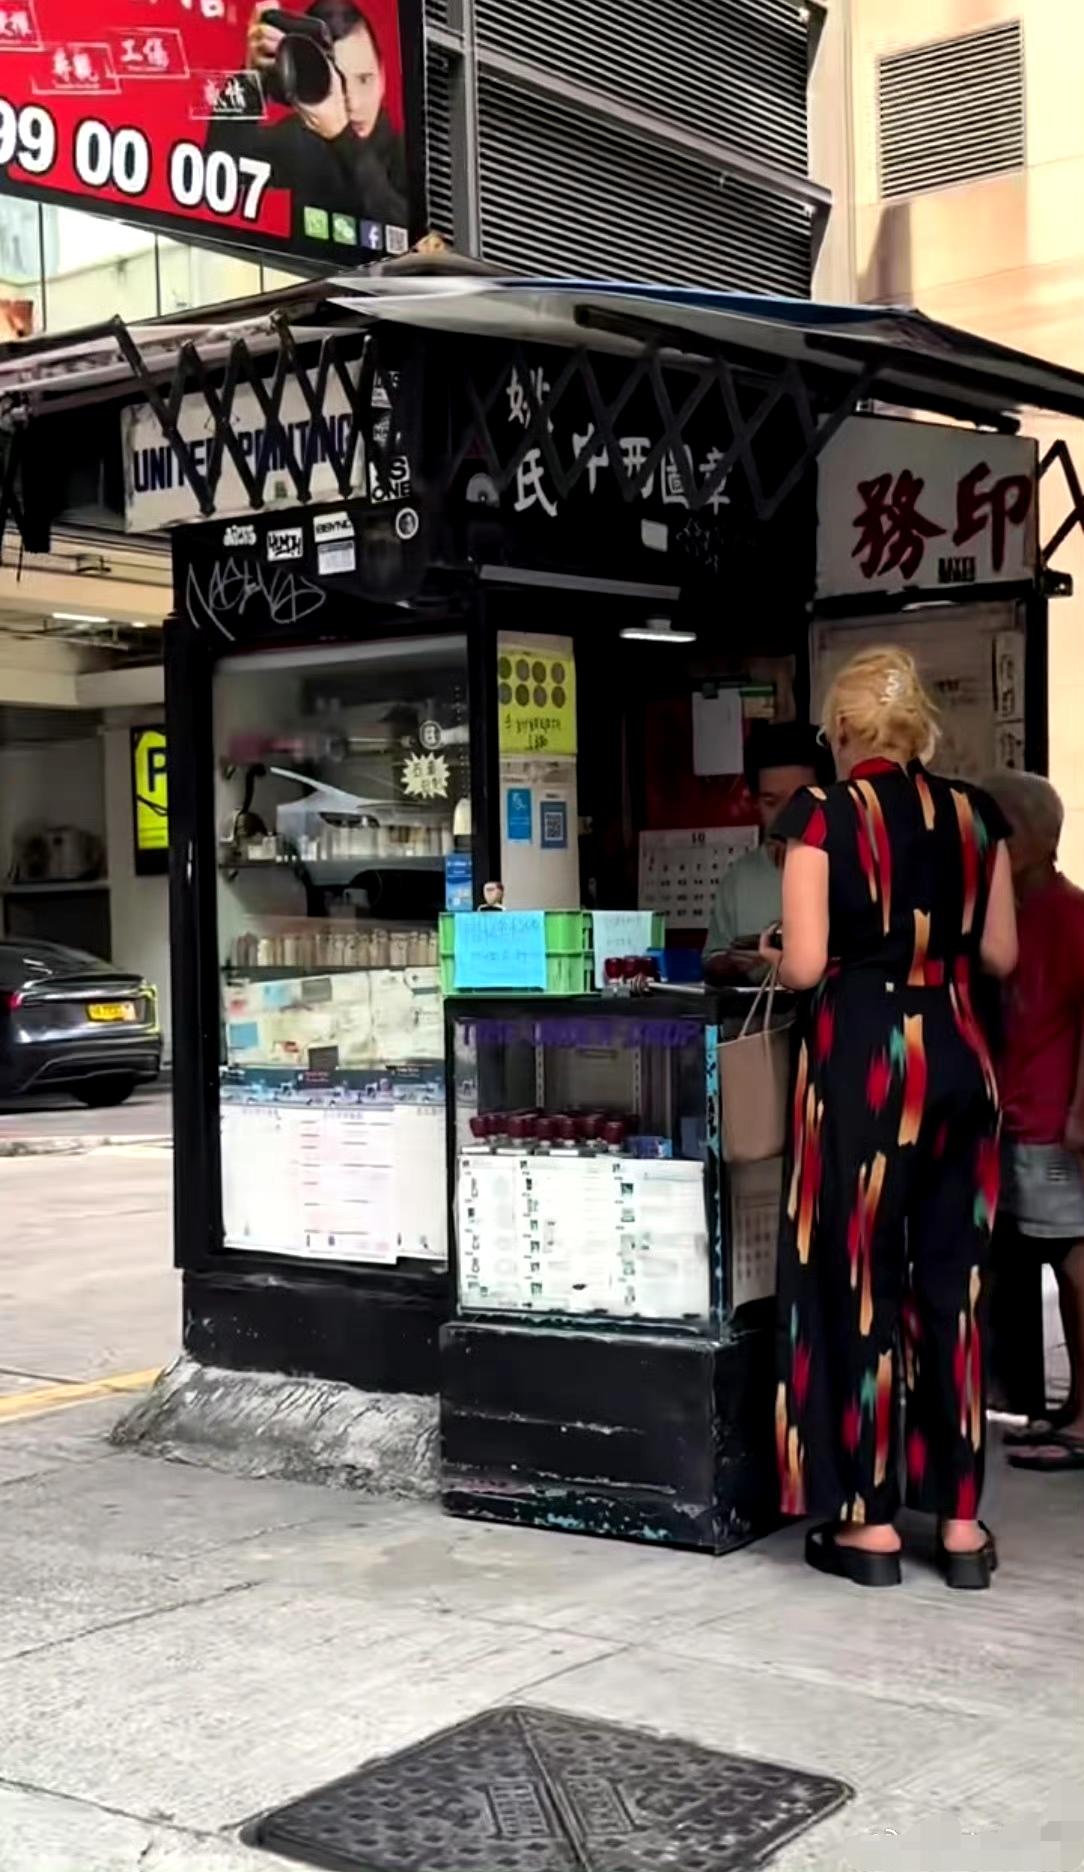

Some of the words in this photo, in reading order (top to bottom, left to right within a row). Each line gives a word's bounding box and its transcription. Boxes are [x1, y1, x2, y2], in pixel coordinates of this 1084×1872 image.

[75, 120, 149, 193] 00
[169, 143, 271, 219] 007
[133, 437, 218, 493] UNITE
